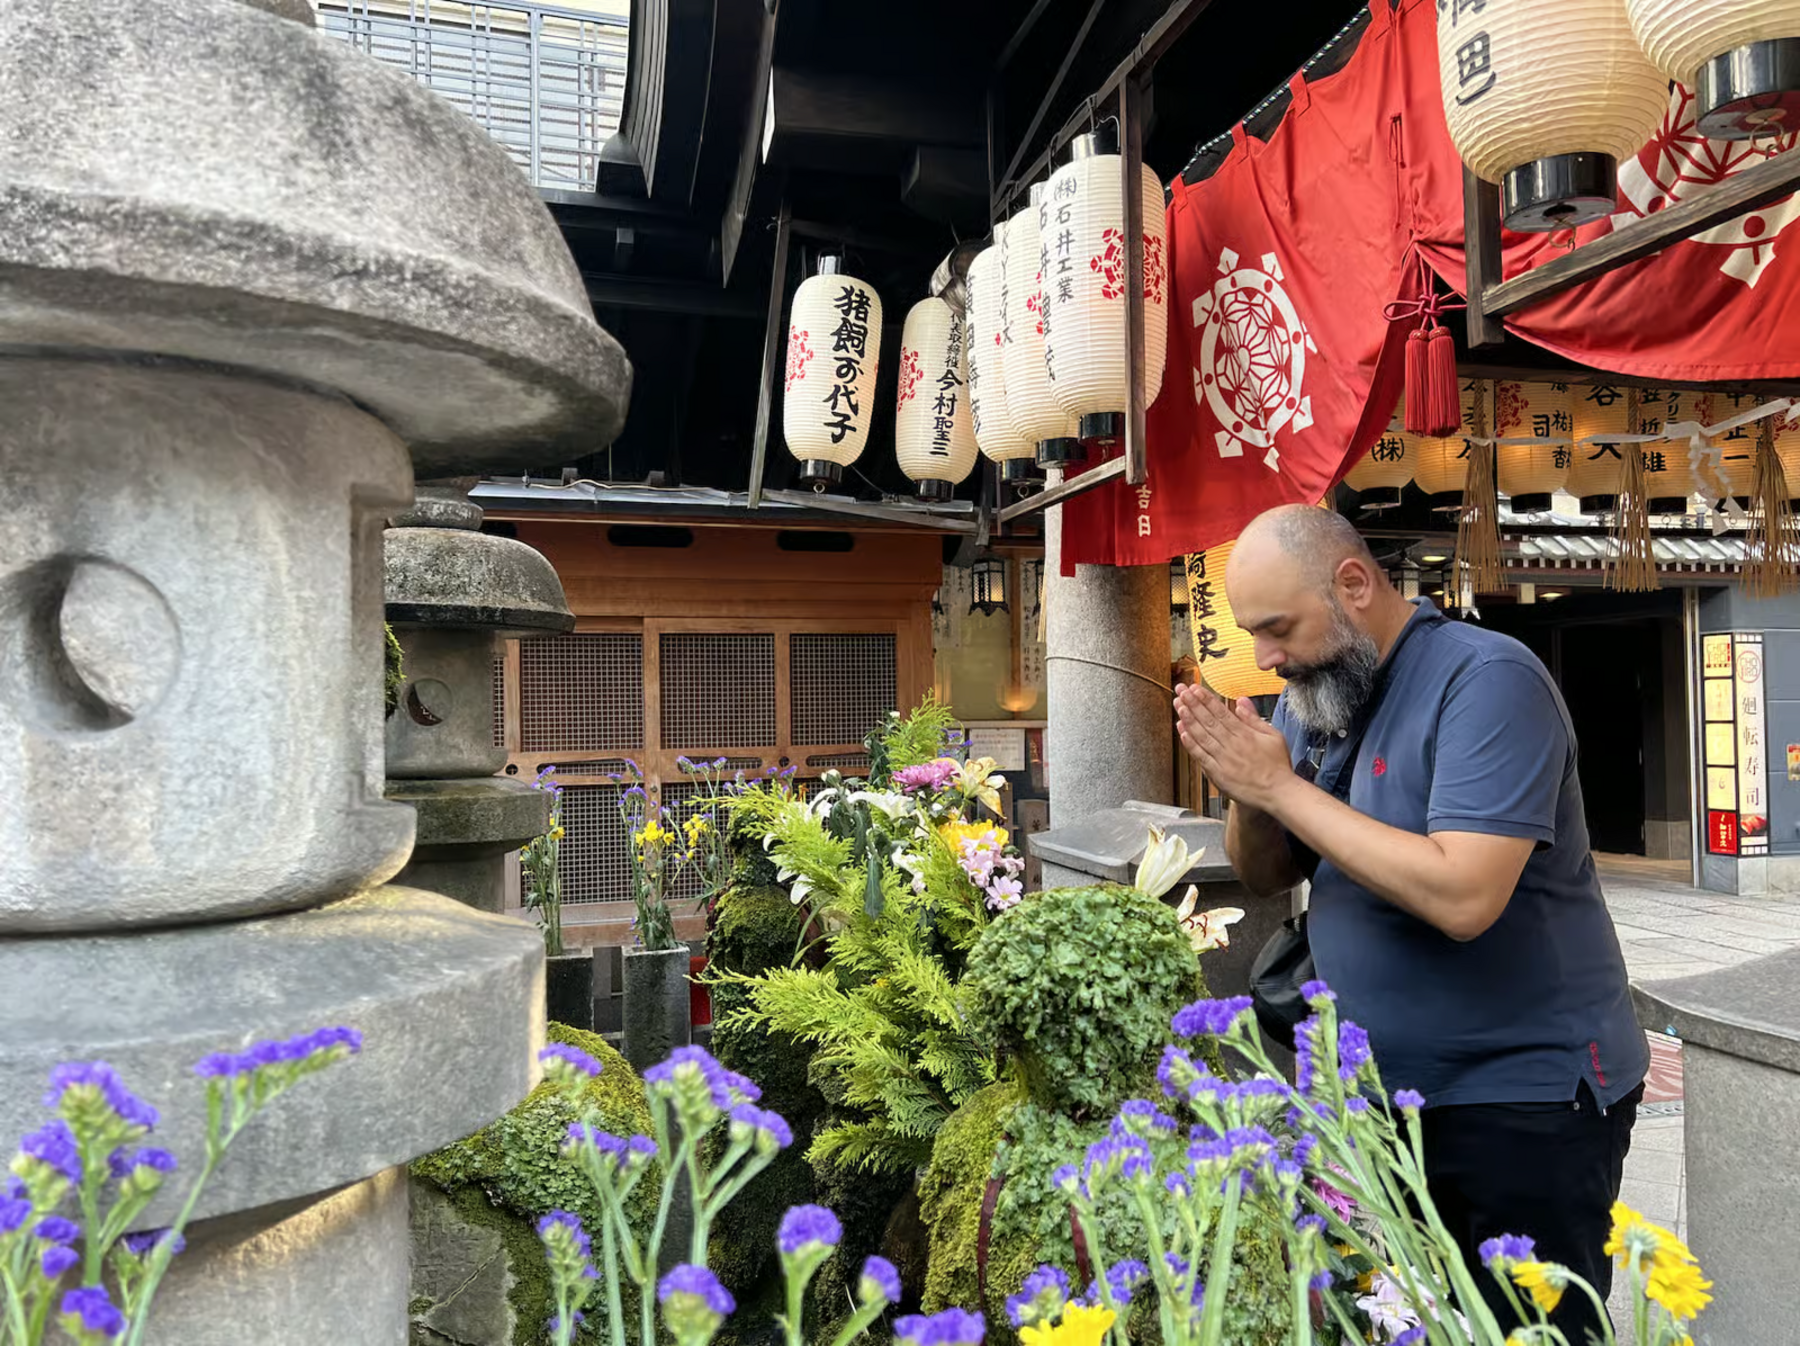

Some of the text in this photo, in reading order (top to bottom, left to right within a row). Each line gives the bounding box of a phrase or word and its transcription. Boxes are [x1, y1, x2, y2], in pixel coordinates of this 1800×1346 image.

[1054, 177, 1076, 303] (株)石井工業
[930, 369, 963, 456] 今村聖三
[1371, 437, 1404, 462] (株)
[1135, 484, 1152, 537] 吉日
[1742, 697, 1759, 806] 廻転寿司
